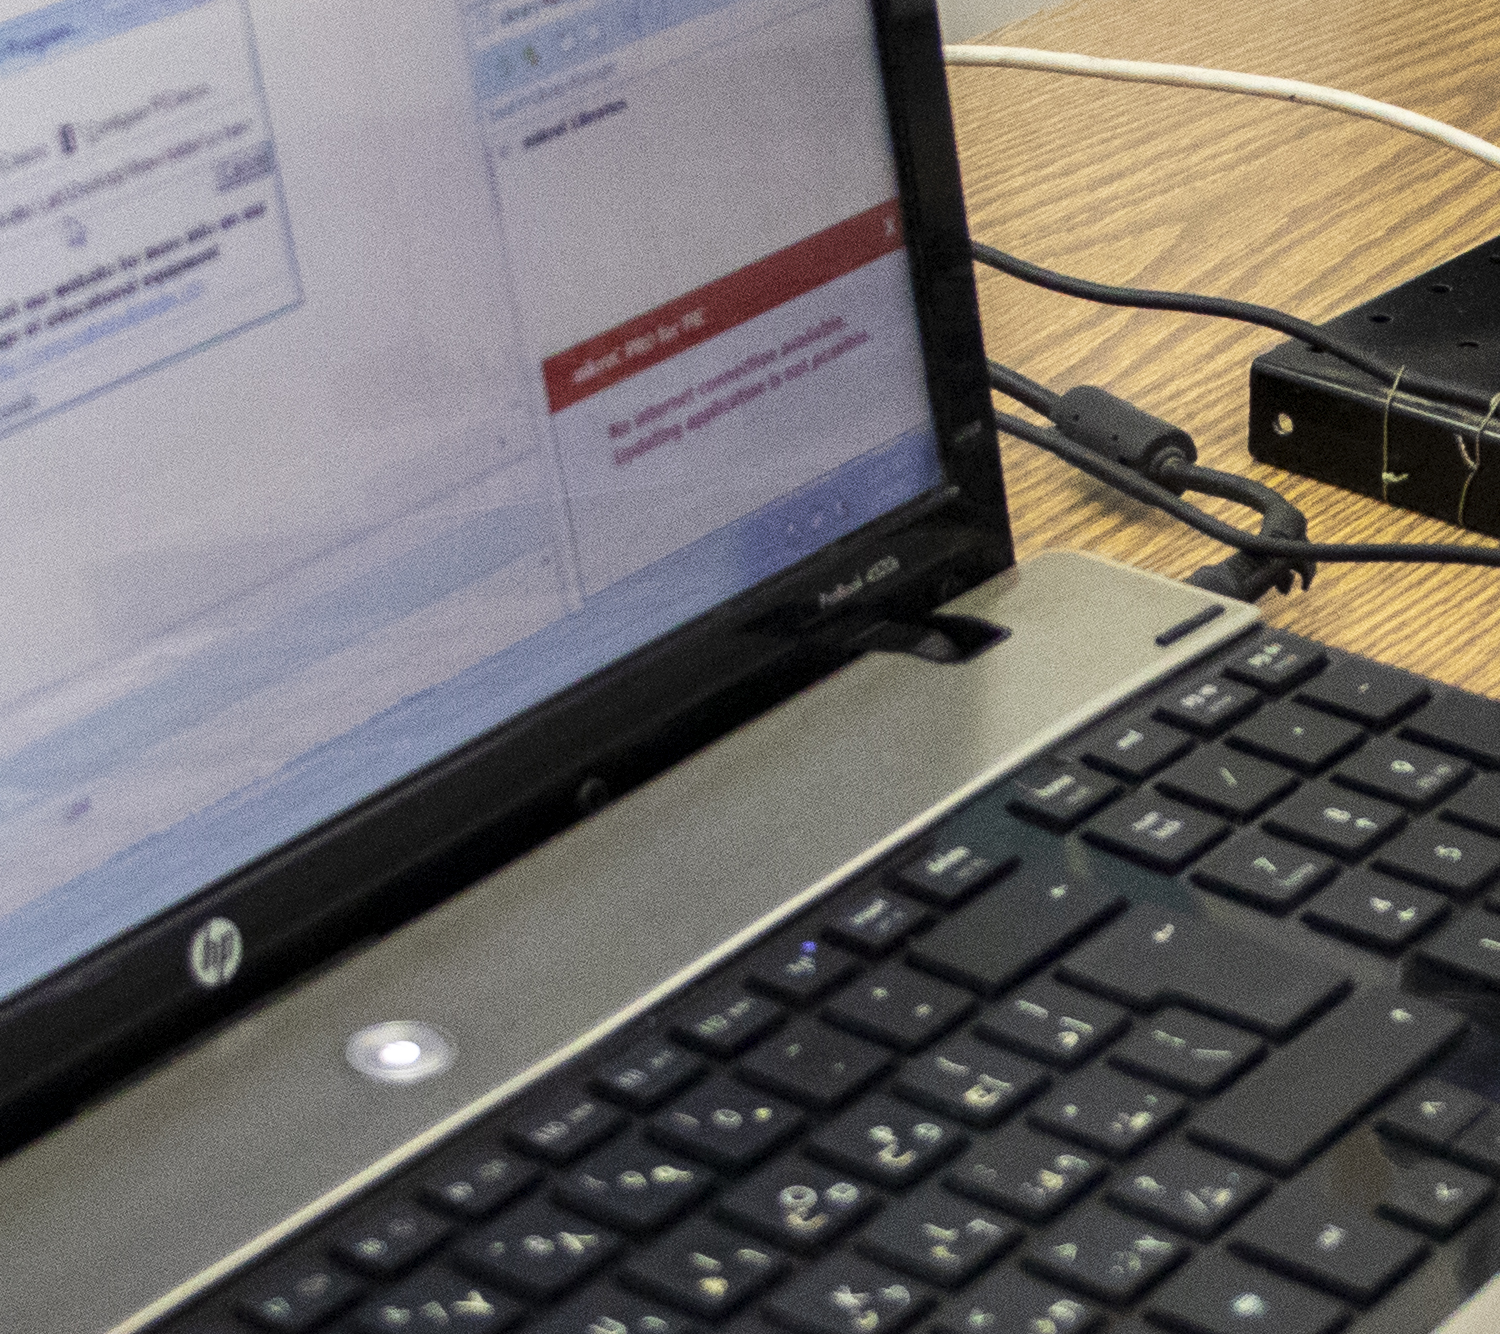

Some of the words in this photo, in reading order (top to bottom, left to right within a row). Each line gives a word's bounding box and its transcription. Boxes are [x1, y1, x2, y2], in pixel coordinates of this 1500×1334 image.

[634, 385, 694, 427] internet
[697, 345, 777, 396] connection
[685, 377, 765, 432] application
